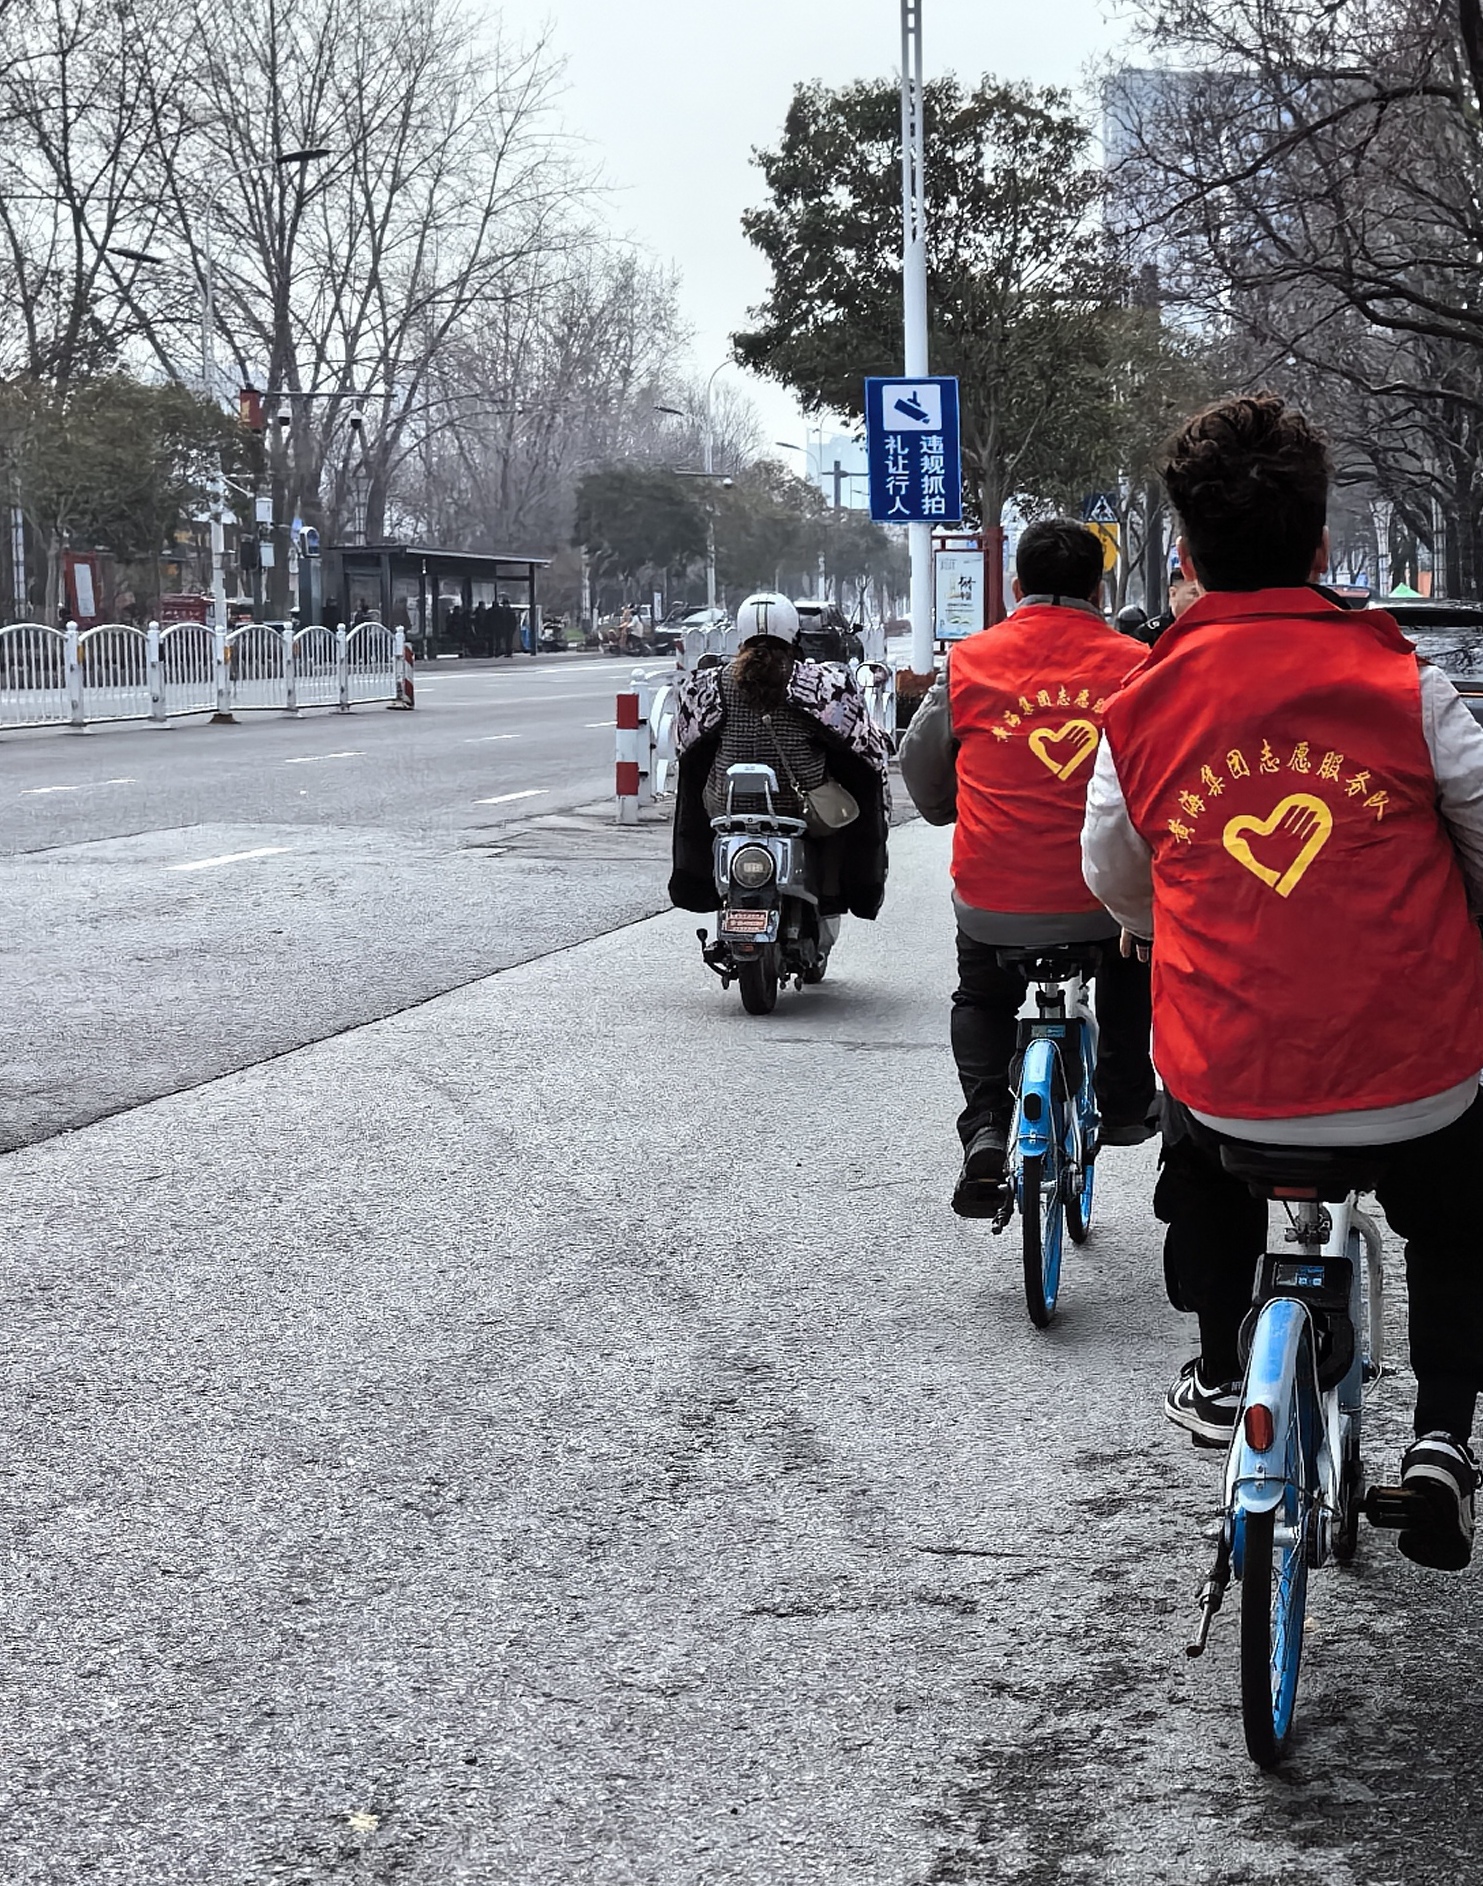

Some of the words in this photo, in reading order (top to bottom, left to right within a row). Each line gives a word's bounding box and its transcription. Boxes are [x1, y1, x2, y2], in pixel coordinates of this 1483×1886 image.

[884, 435, 911, 516] 礼让行人
[920, 435, 946, 516] 违规抓拍
